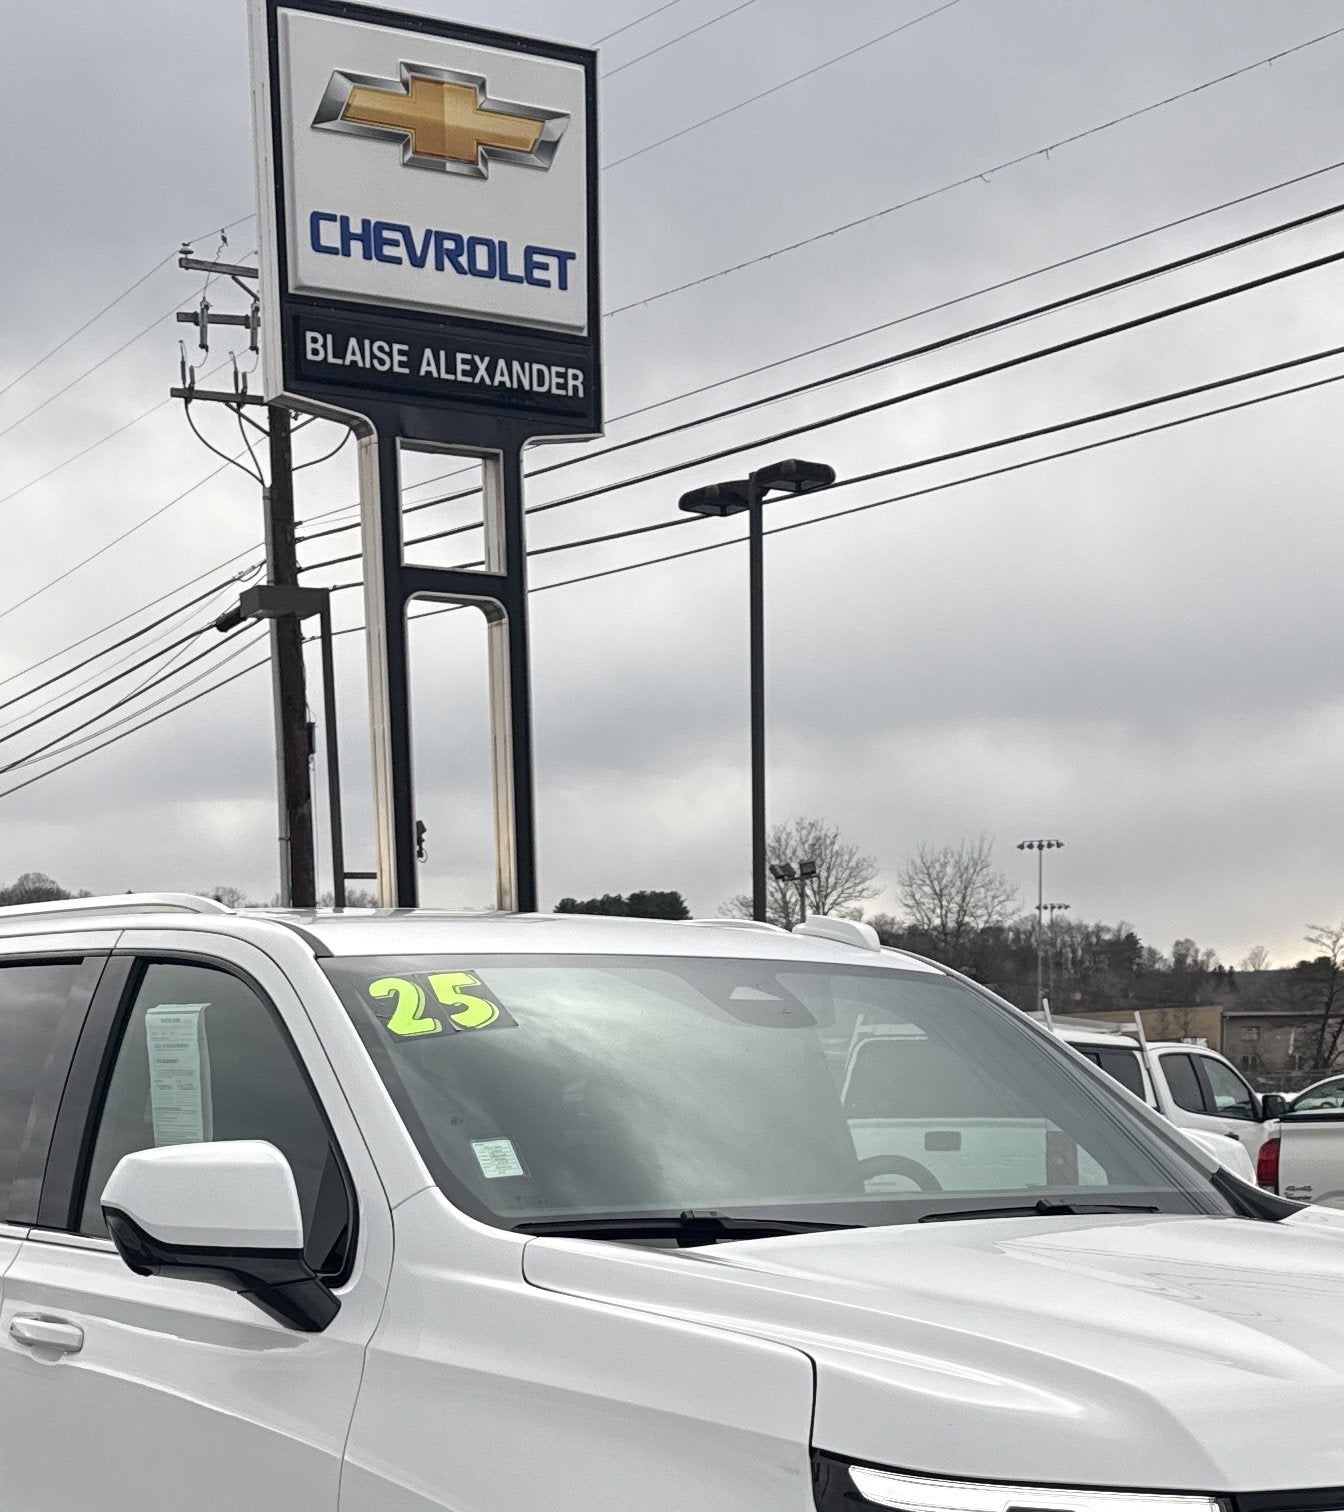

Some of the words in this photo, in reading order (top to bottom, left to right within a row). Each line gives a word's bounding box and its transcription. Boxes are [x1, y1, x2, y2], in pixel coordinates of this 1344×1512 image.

[310, 210, 576, 291] CHEVROLET
[305, 331, 410, 374] BLAISE
[419, 348, 585, 398] ALEXANDER
[369, 972, 500, 1036] 25
